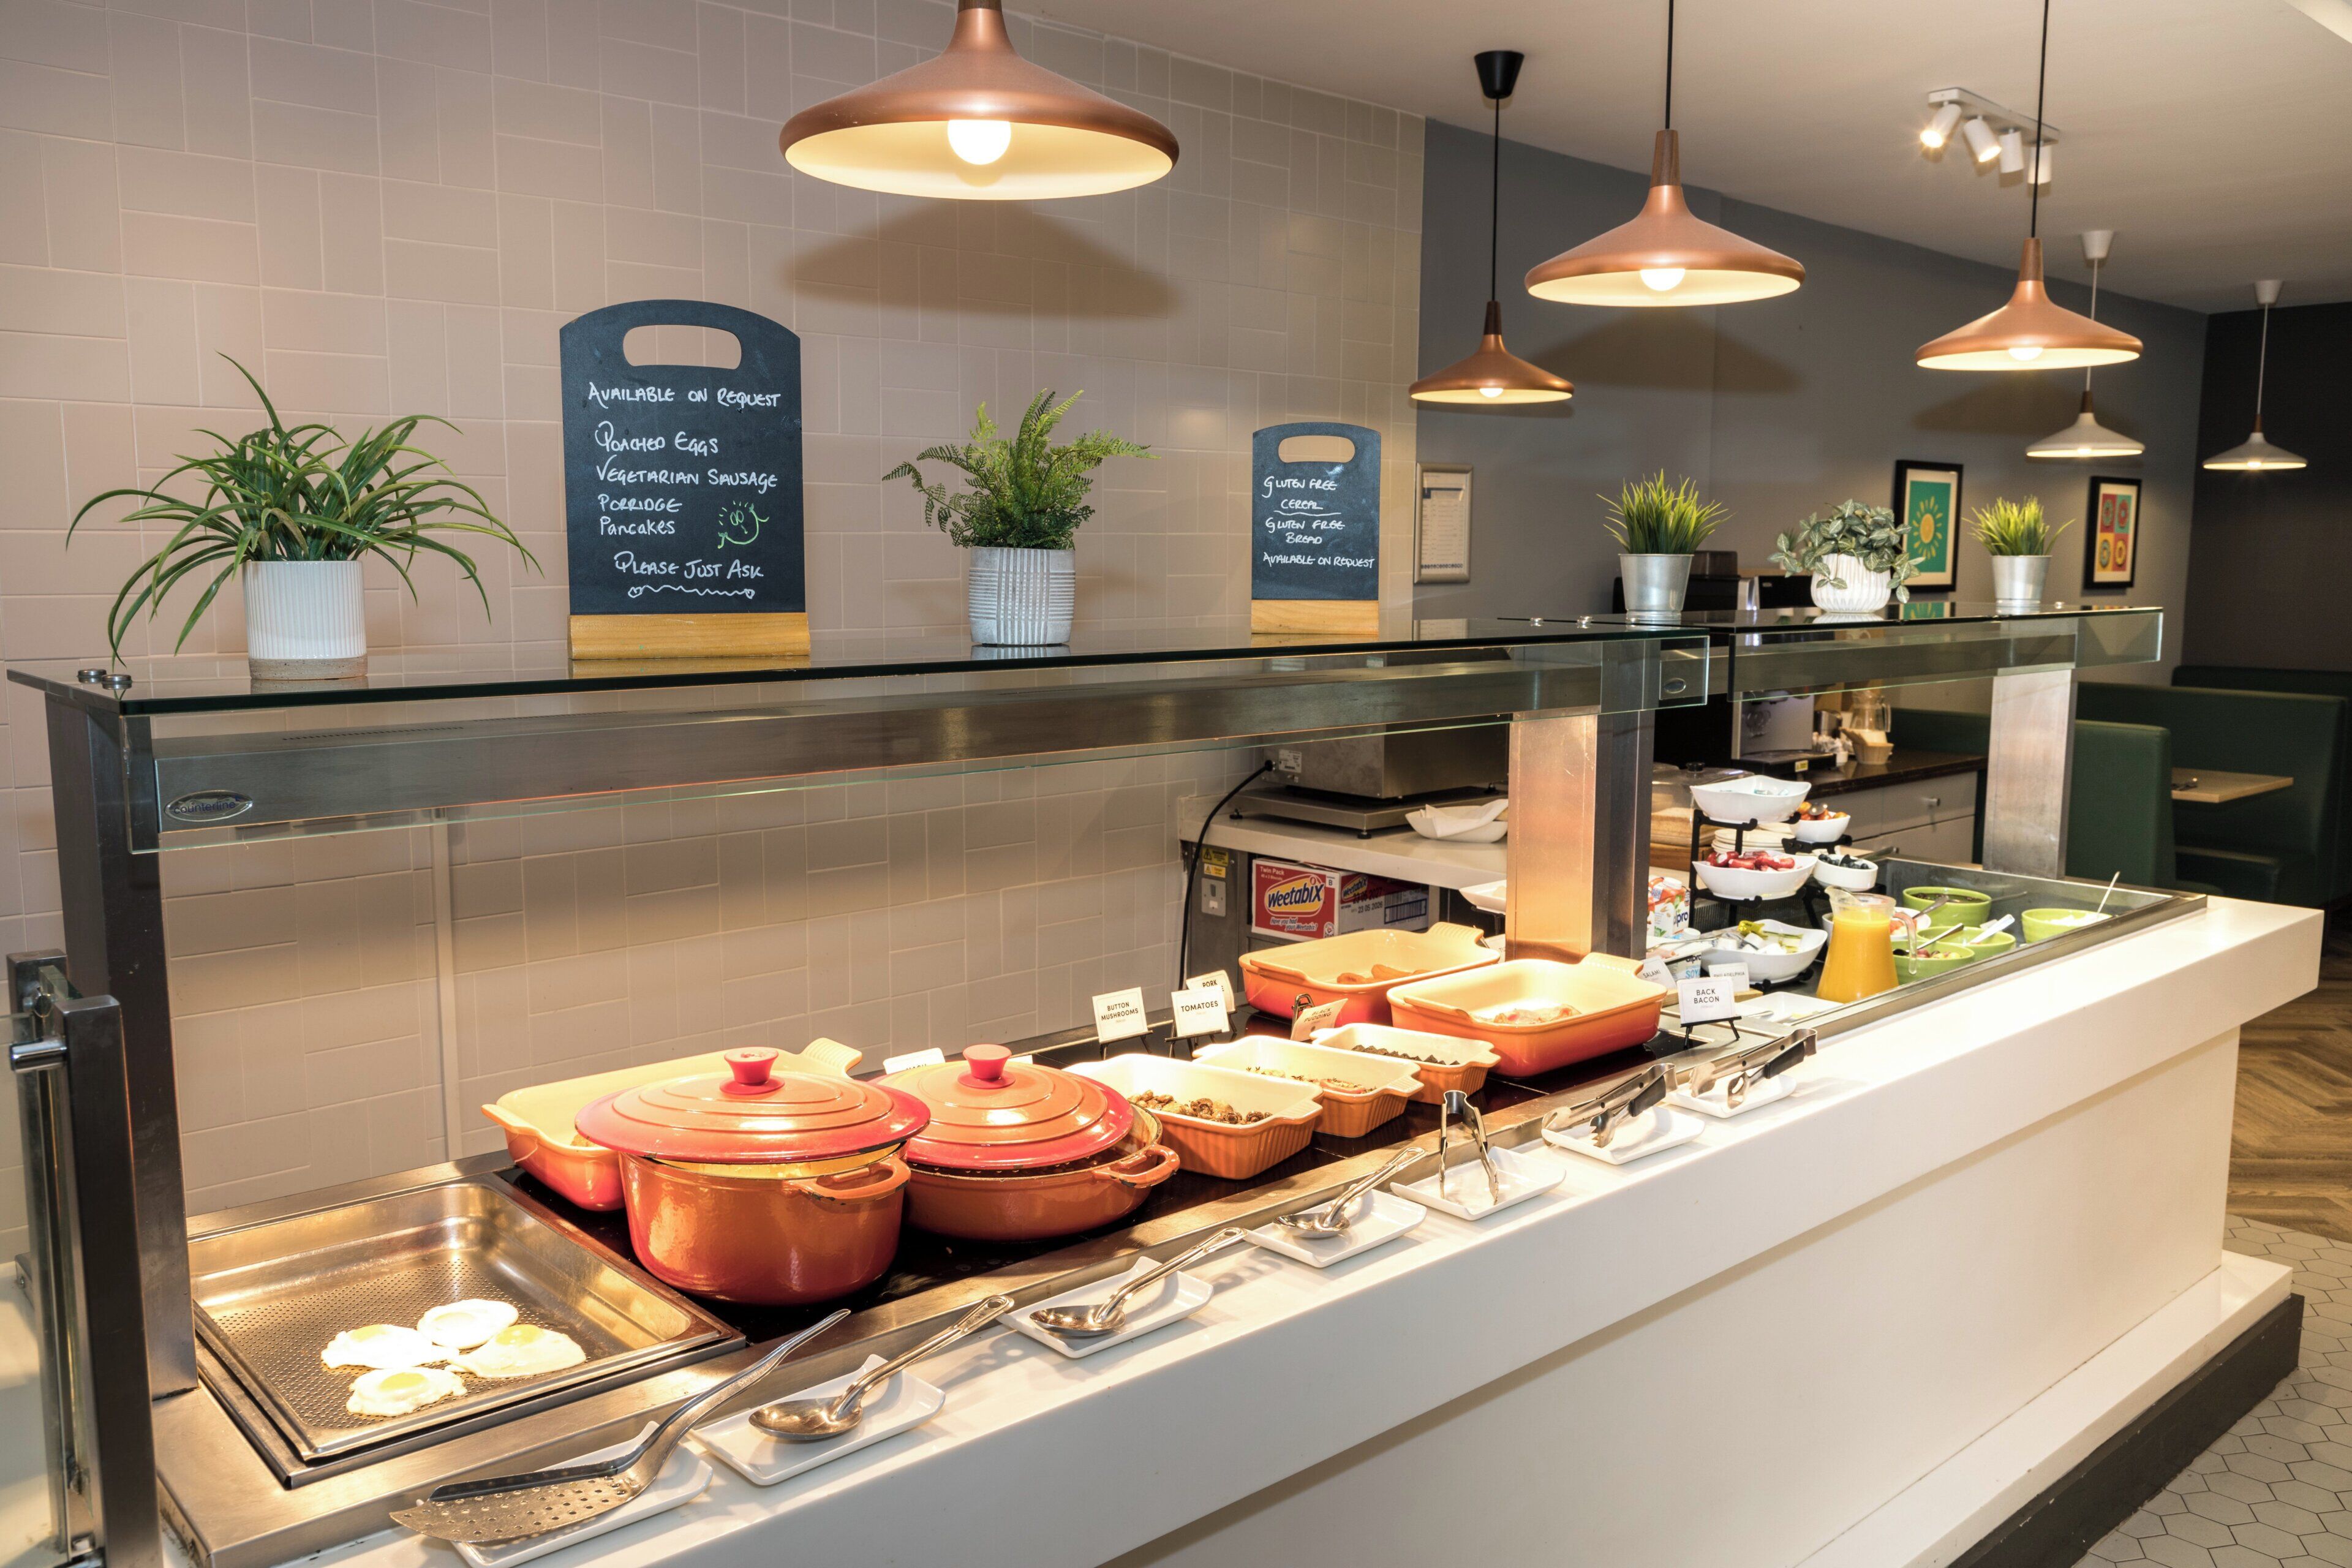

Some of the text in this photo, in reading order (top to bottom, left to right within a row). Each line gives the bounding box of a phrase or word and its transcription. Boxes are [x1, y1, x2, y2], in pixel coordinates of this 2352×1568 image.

[589, 382, 781, 409] AVAILABLE ON REQUEST
[597, 493, 683, 513] PORRIDGE
[1281, 499, 1323, 510] CEREAL
[1286, 532, 1322, 545] BREAD
[1317, 556, 1333, 565] ON
[173, 801, 236, 814] counterline
[1643, 970, 1661, 978] SALAMI
[1107, 1001, 1129, 1011] BUTTON
[1181, 1000, 1218, 1012] TOMATOES
[1101, 1008, 1139, 1021] MUSHROOMS
[1304, 1012, 1332, 1022] PUDDING
